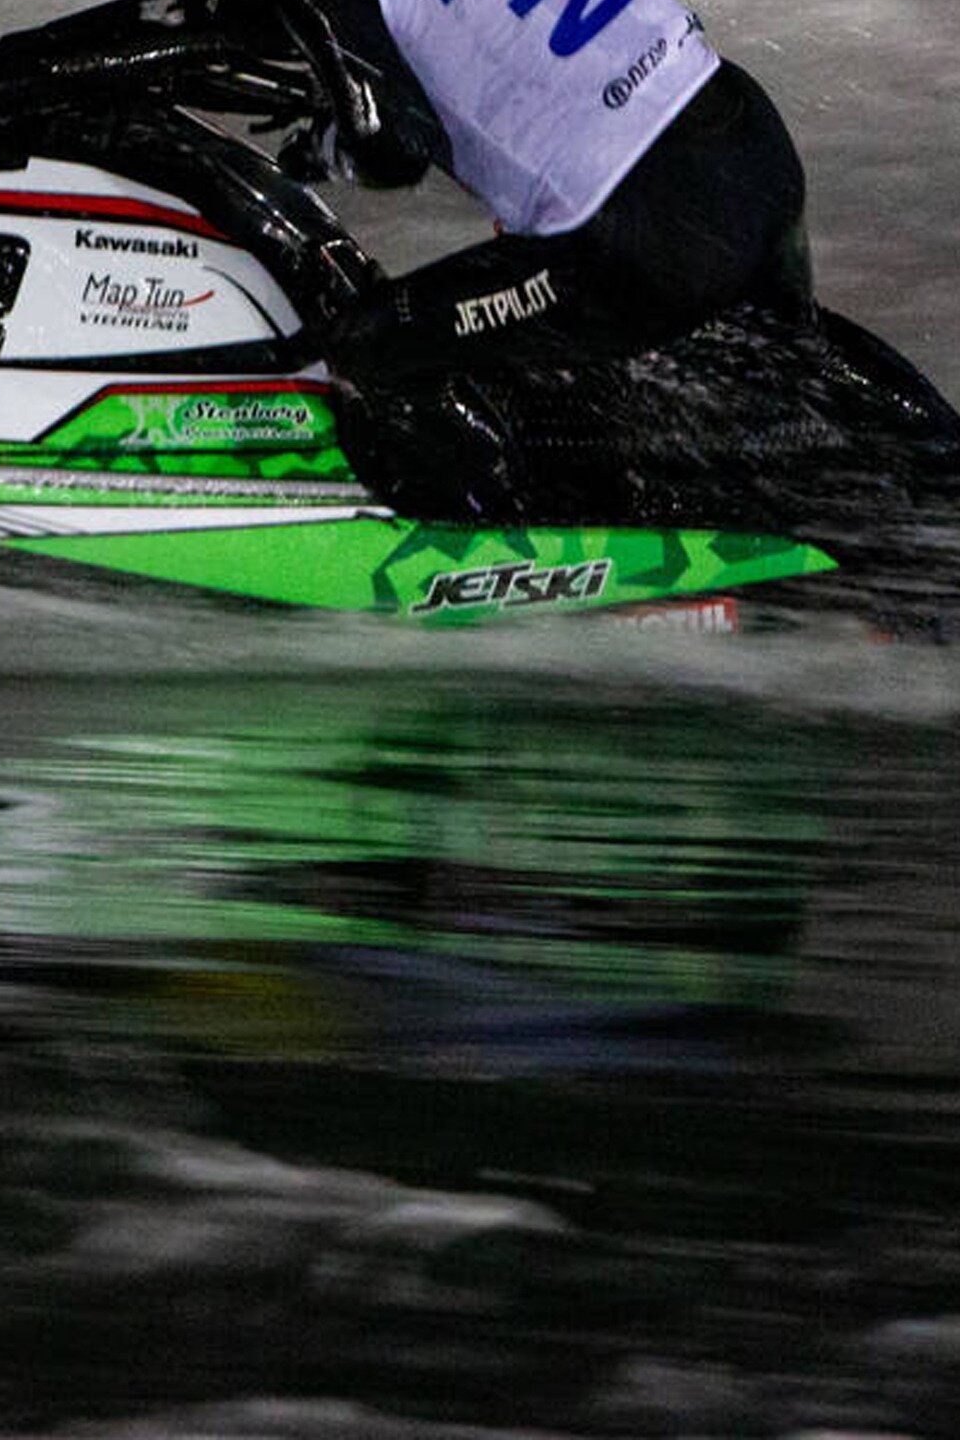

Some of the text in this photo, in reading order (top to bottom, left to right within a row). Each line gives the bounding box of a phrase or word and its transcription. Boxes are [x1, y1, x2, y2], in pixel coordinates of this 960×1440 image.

[74, 229, 198, 258] Kawasaki
[82, 272, 186, 310] Map Tun
[454, 268, 558, 337] JETPILOT
